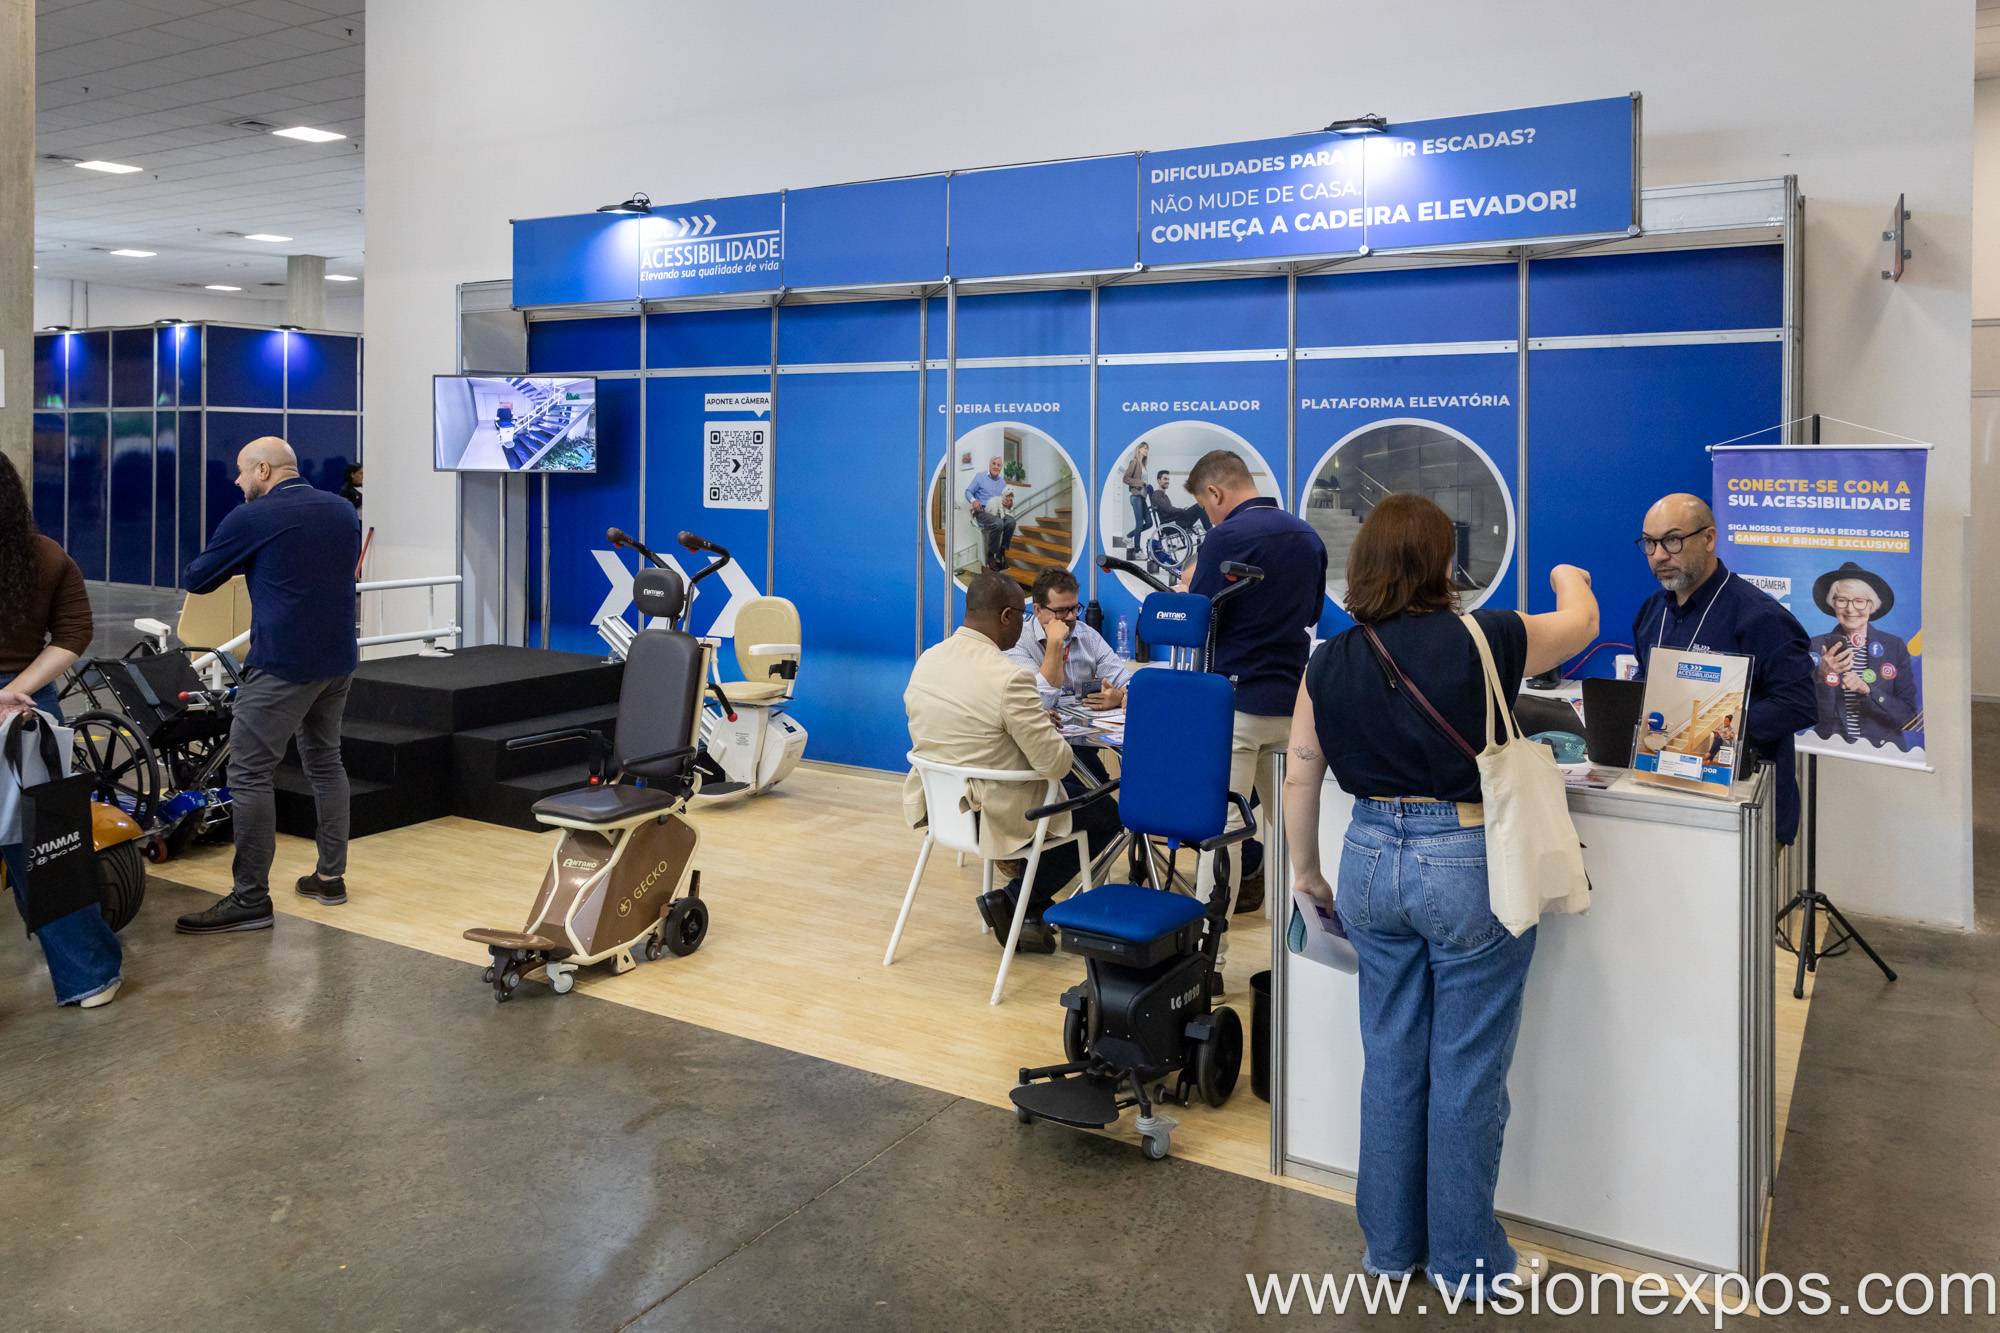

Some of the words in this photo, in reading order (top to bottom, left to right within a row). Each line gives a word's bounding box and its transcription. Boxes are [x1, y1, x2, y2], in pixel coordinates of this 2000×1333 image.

[1151, 156, 1285, 184] DIFICULDADES
[1291, 149, 1345, 169] PARA
[1422, 128, 1536, 155] ESCADAS?
[1151, 193, 1193, 215] NÃO
[1199, 189, 1259, 210] MUDE
[1266, 185, 1294, 204] DE
[1300, 181, 1362, 201] CASA.
[1151, 217, 1264, 243] CONHEÇA
[1269, 215, 1289, 234] A
[1294, 204, 1411, 232] CADEIRA
[1418, 189, 1577, 222] ELEVADOR!
[641, 237, 780, 270] ACESSIBILIDADE
[640, 269, 679, 281] Elevando
[681, 269, 696, 278] sua
[698, 263, 742, 279] qualidade
[745, 262, 757, 273] de
[759, 260, 779, 272] vida
[741, 396, 770, 405] CÂMERA
[938, 403, 991, 414] CDEIRA
[994, 402, 1060, 413] ELEVADOR
[1122, 401, 1169, 412] CARRO
[1173, 400, 1260, 411] ESCALADOR
[1301, 397, 1405, 409] PLATAFORMA
[1409, 393, 1511, 408] ELEVATÓRIA
[1728, 479, 1838, 493] CONECTE-SE
[1843, 480, 1889, 494] COM
[1895, 480, 1911, 494] A
[1728, 494, 1758, 507] SUL
[1762, 495, 1911, 511] ACESSIBILIDADE
[1837, 528, 1868, 536] REDES
[1735, 534, 1770, 543] GANHE
[1773, 536, 1790, 544] UM
[1792, 537, 1834, 546] BRINDE
[1838, 538, 1907, 550] EXCLUSIVO!
[1760, 578, 1787, 590] CÂMERA
[36, 831, 80, 855] VIAMAR
[562, 858, 598, 869] ANTANO
[633, 860, 668, 899] GECKO
